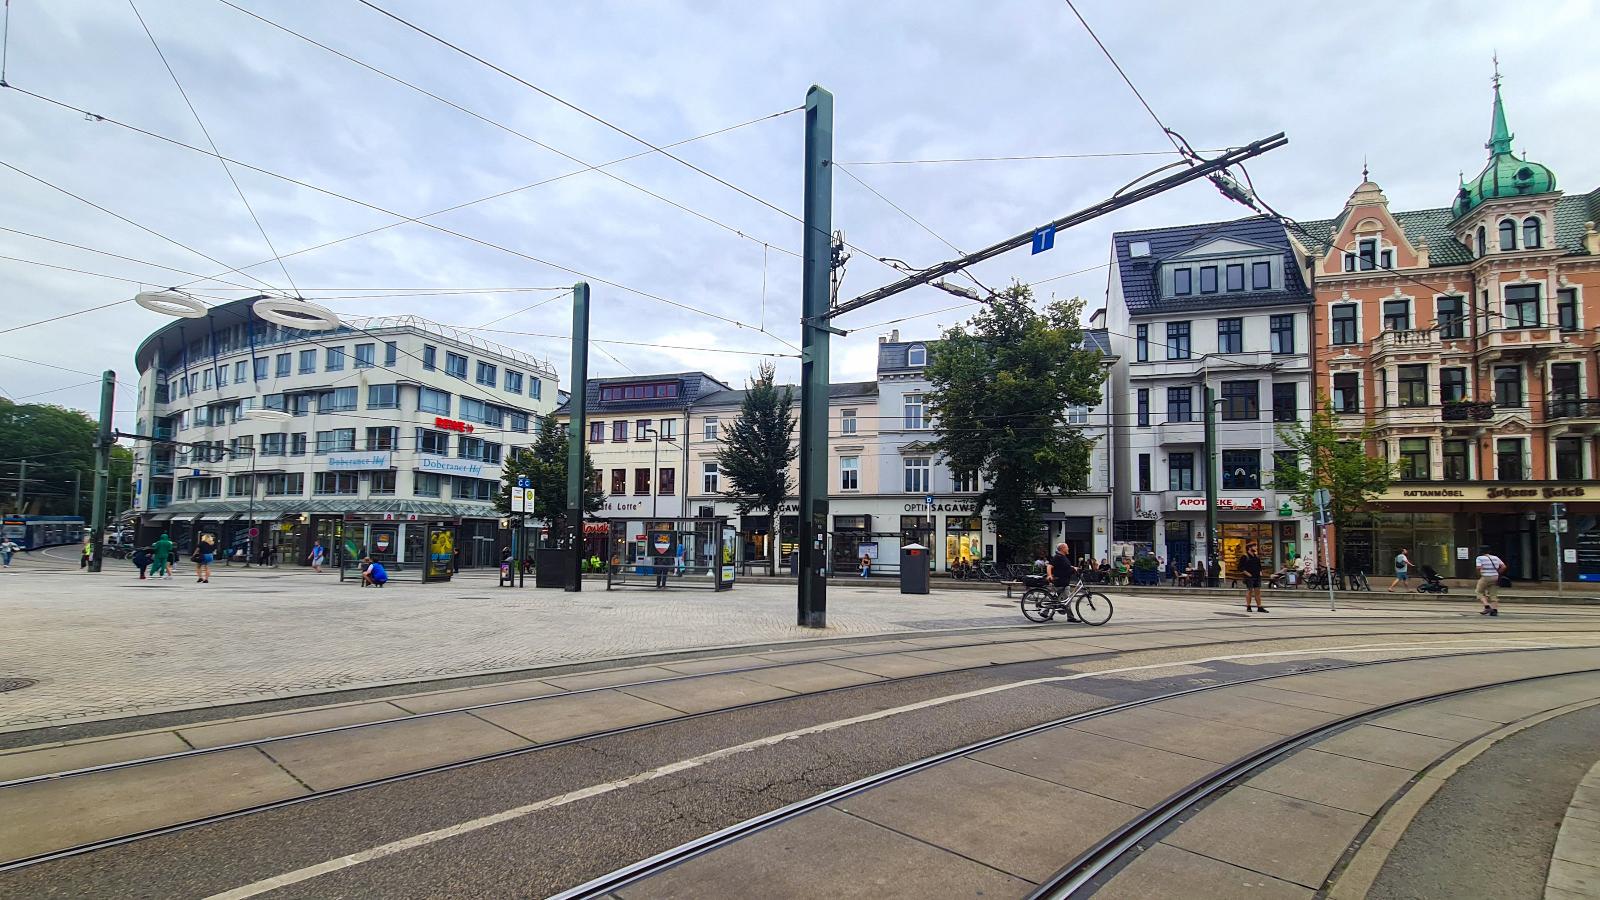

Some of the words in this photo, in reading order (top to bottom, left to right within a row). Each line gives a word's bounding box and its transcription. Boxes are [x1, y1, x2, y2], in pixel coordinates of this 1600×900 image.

[423, 459, 466, 471] Doberaner
[1403, 489, 1464, 497] RATTANMÖBEL
[931, 504, 975, 512] SAGAWE
